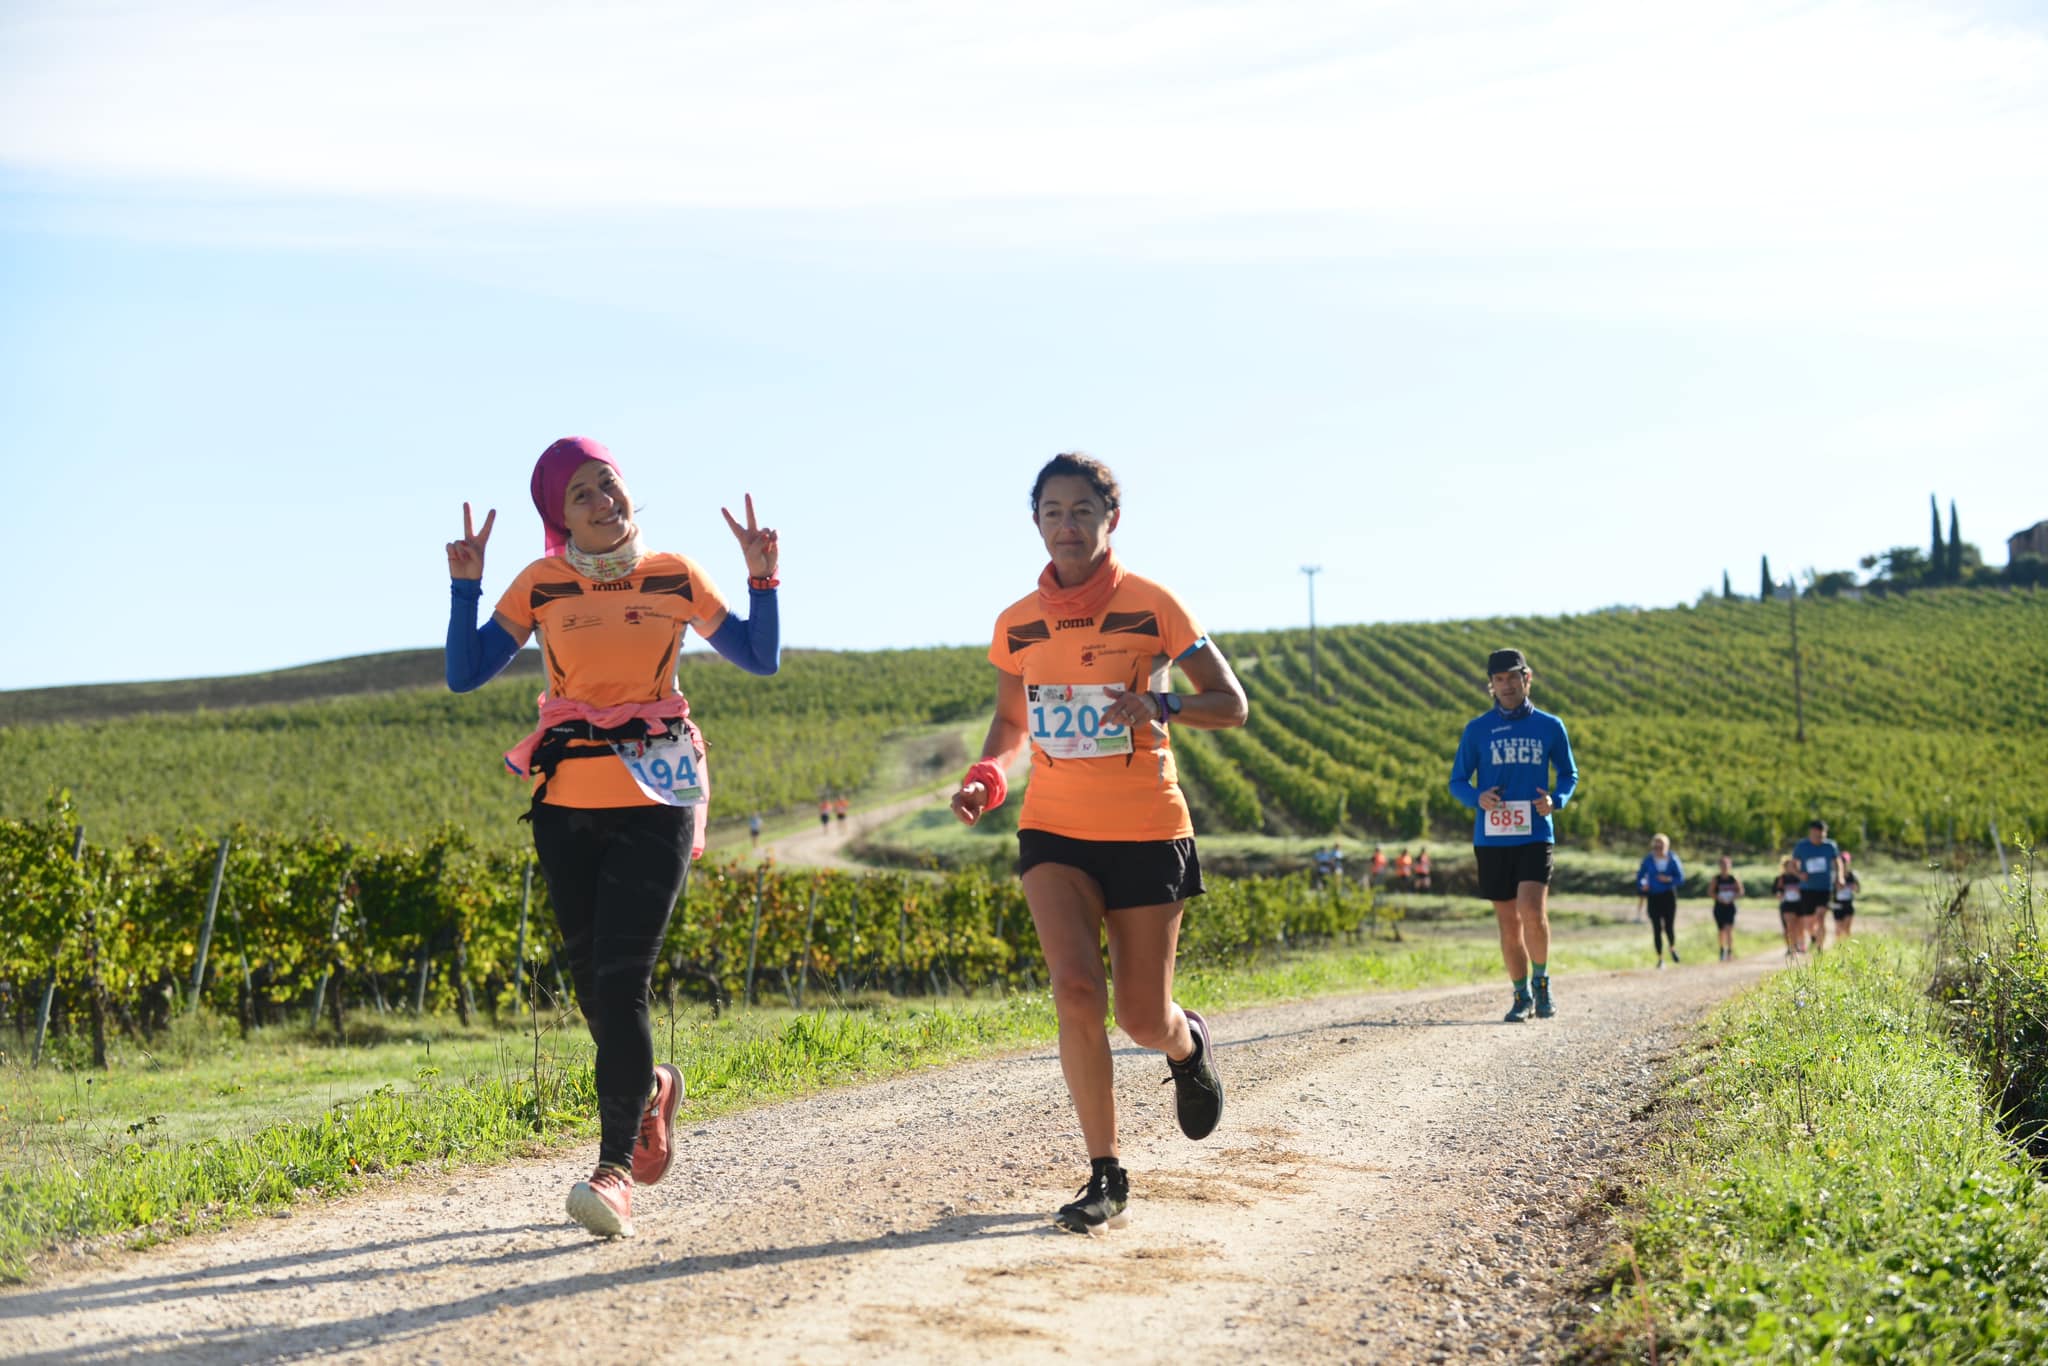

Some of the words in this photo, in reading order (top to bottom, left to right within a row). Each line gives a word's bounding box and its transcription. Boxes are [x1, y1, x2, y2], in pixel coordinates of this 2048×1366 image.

[1489, 737, 1543, 750] ATLETICA
[1491, 747, 1543, 765] ARCE
[1490, 810, 1524, 826] 685
